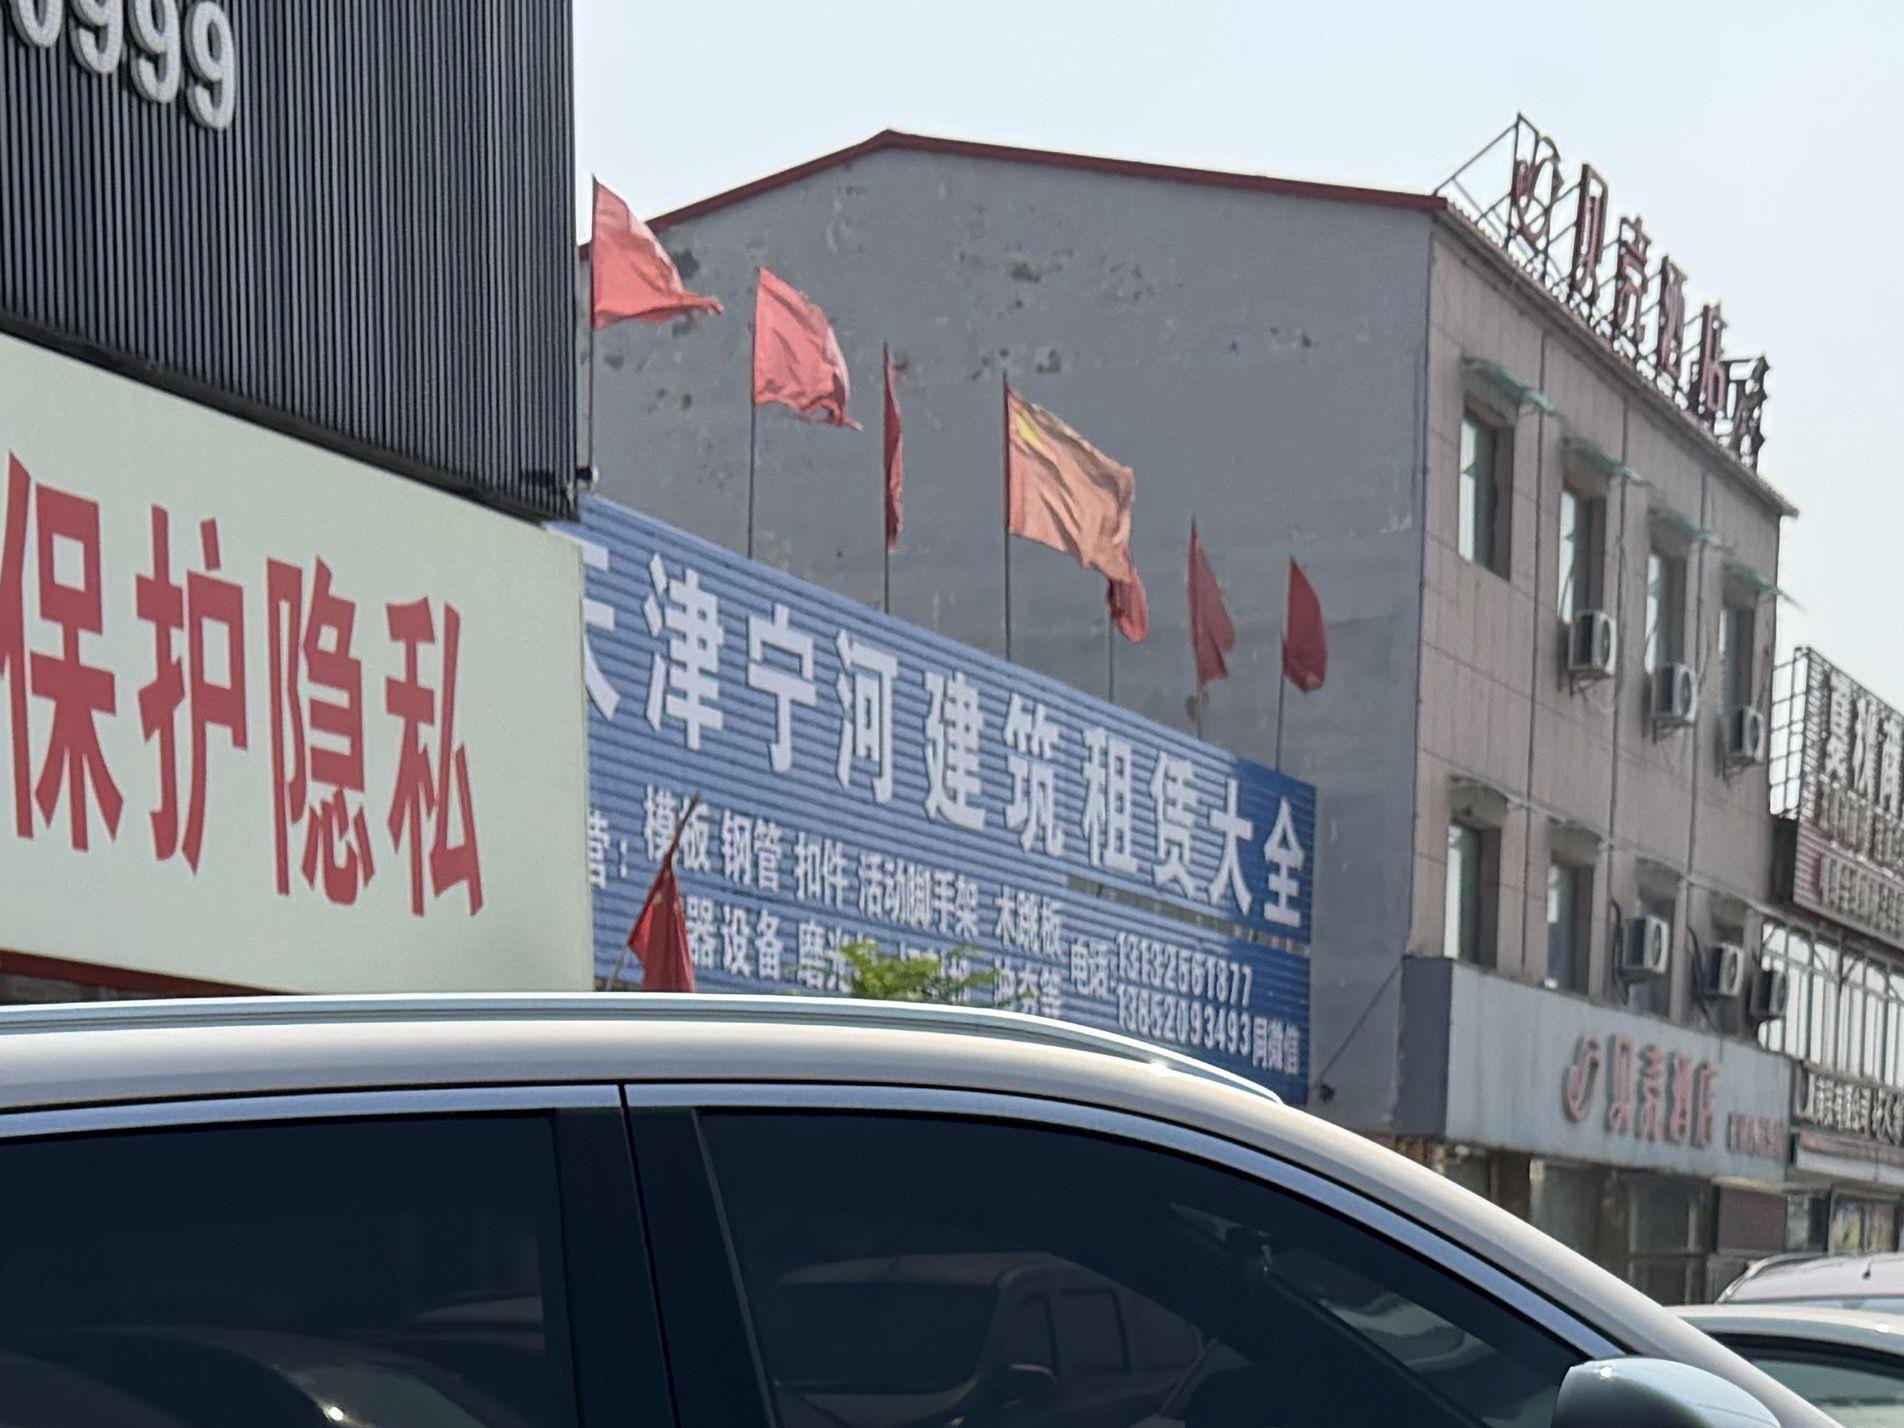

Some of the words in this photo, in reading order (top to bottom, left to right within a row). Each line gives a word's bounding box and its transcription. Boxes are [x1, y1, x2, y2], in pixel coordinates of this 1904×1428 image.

[643, 783, 711, 874] 模板
[721, 808, 783, 894] 钢管
[794, 831, 849, 910] 扣件
[858, 851, 980, 939] 活动脚手架
